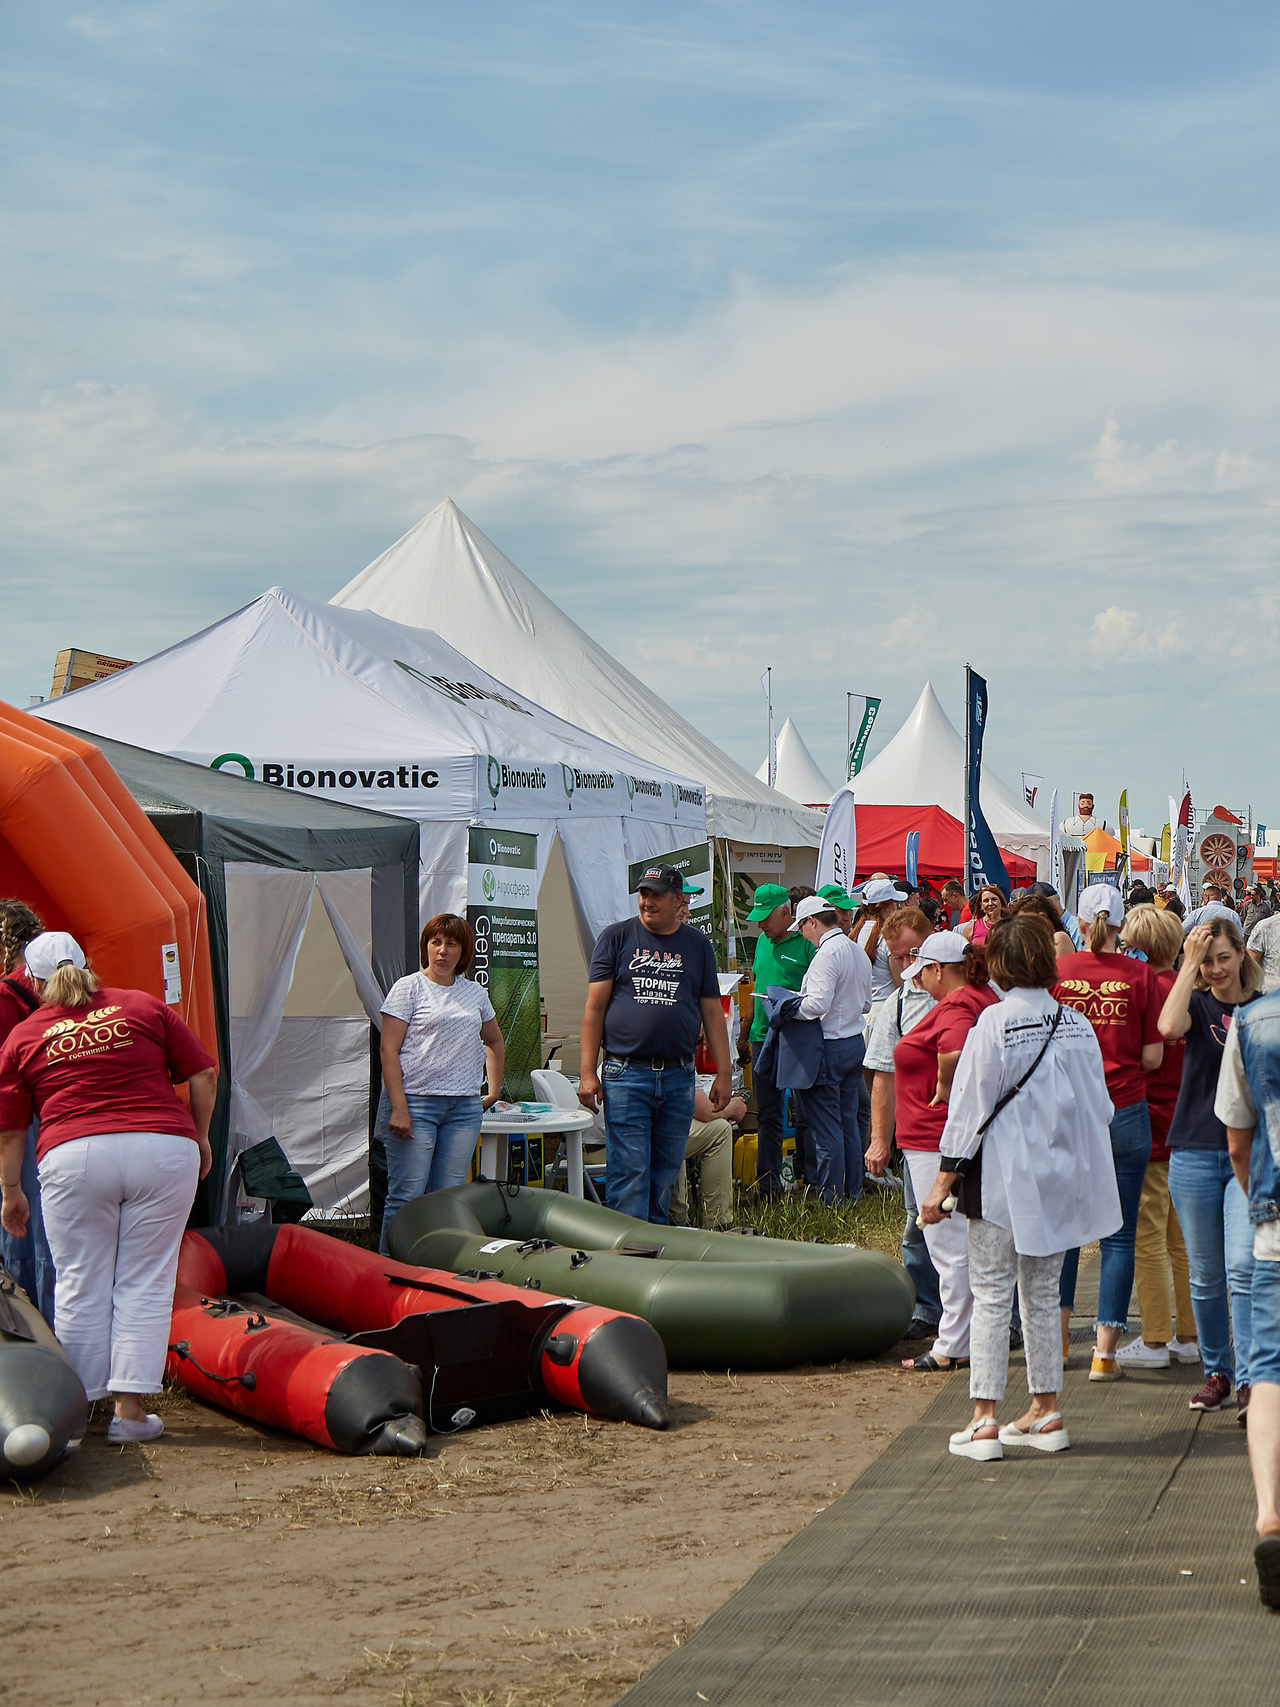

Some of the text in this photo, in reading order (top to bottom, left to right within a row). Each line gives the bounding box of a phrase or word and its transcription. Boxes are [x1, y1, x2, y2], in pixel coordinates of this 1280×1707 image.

[262, 764, 439, 789] Bionovatic
[502, 765, 546, 789] Bionovatic
[573, 768, 615, 789] Bionovatic
[633, 776, 662, 798] Bionovatic
[678, 784, 703, 806] Bionovatic
[497, 843, 521, 855] Bionovatic
[833, 842, 842, 886] ГРО
[497, 879, 530, 898] Агросфера
[492, 932, 537, 946] препараты 3.0
[628, 955, 683, 974] Chapter
[632, 948, 682, 962] JEANS
[46, 1022, 131, 1059] КОЛОС
[69, 1045, 110, 1060] ГОСТИНИЦА
